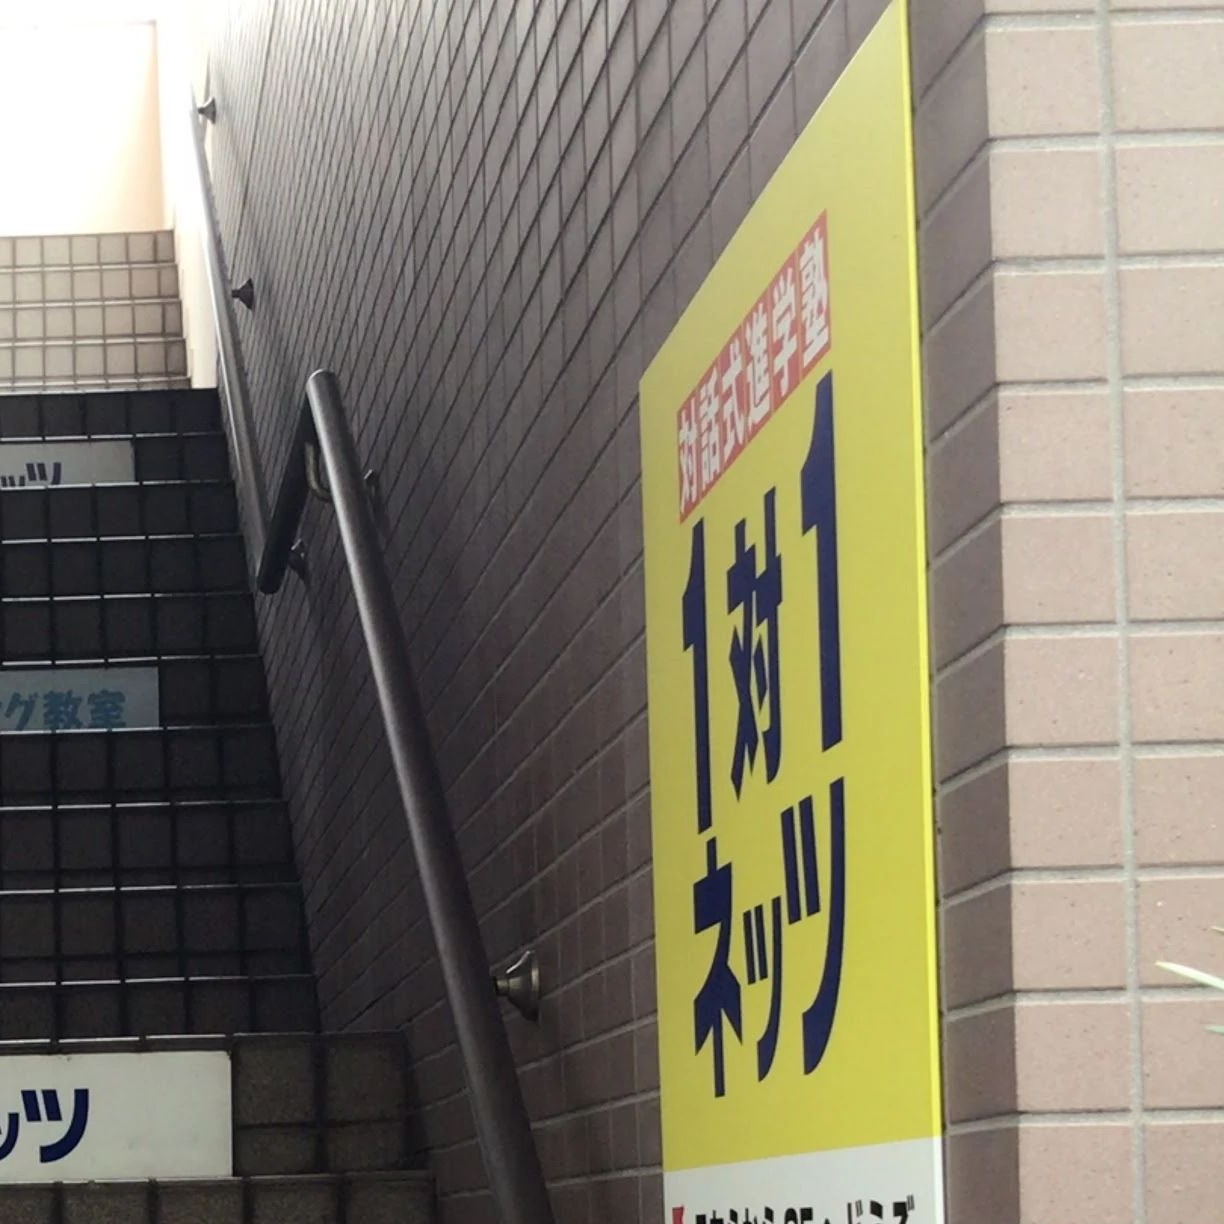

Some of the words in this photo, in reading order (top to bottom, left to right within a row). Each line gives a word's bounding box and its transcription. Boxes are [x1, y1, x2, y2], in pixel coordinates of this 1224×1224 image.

[678, 216, 829, 518] 対話式進学塾
[682, 370, 842, 835] 1対1
[694, 777, 845, 1098] ネッツ
